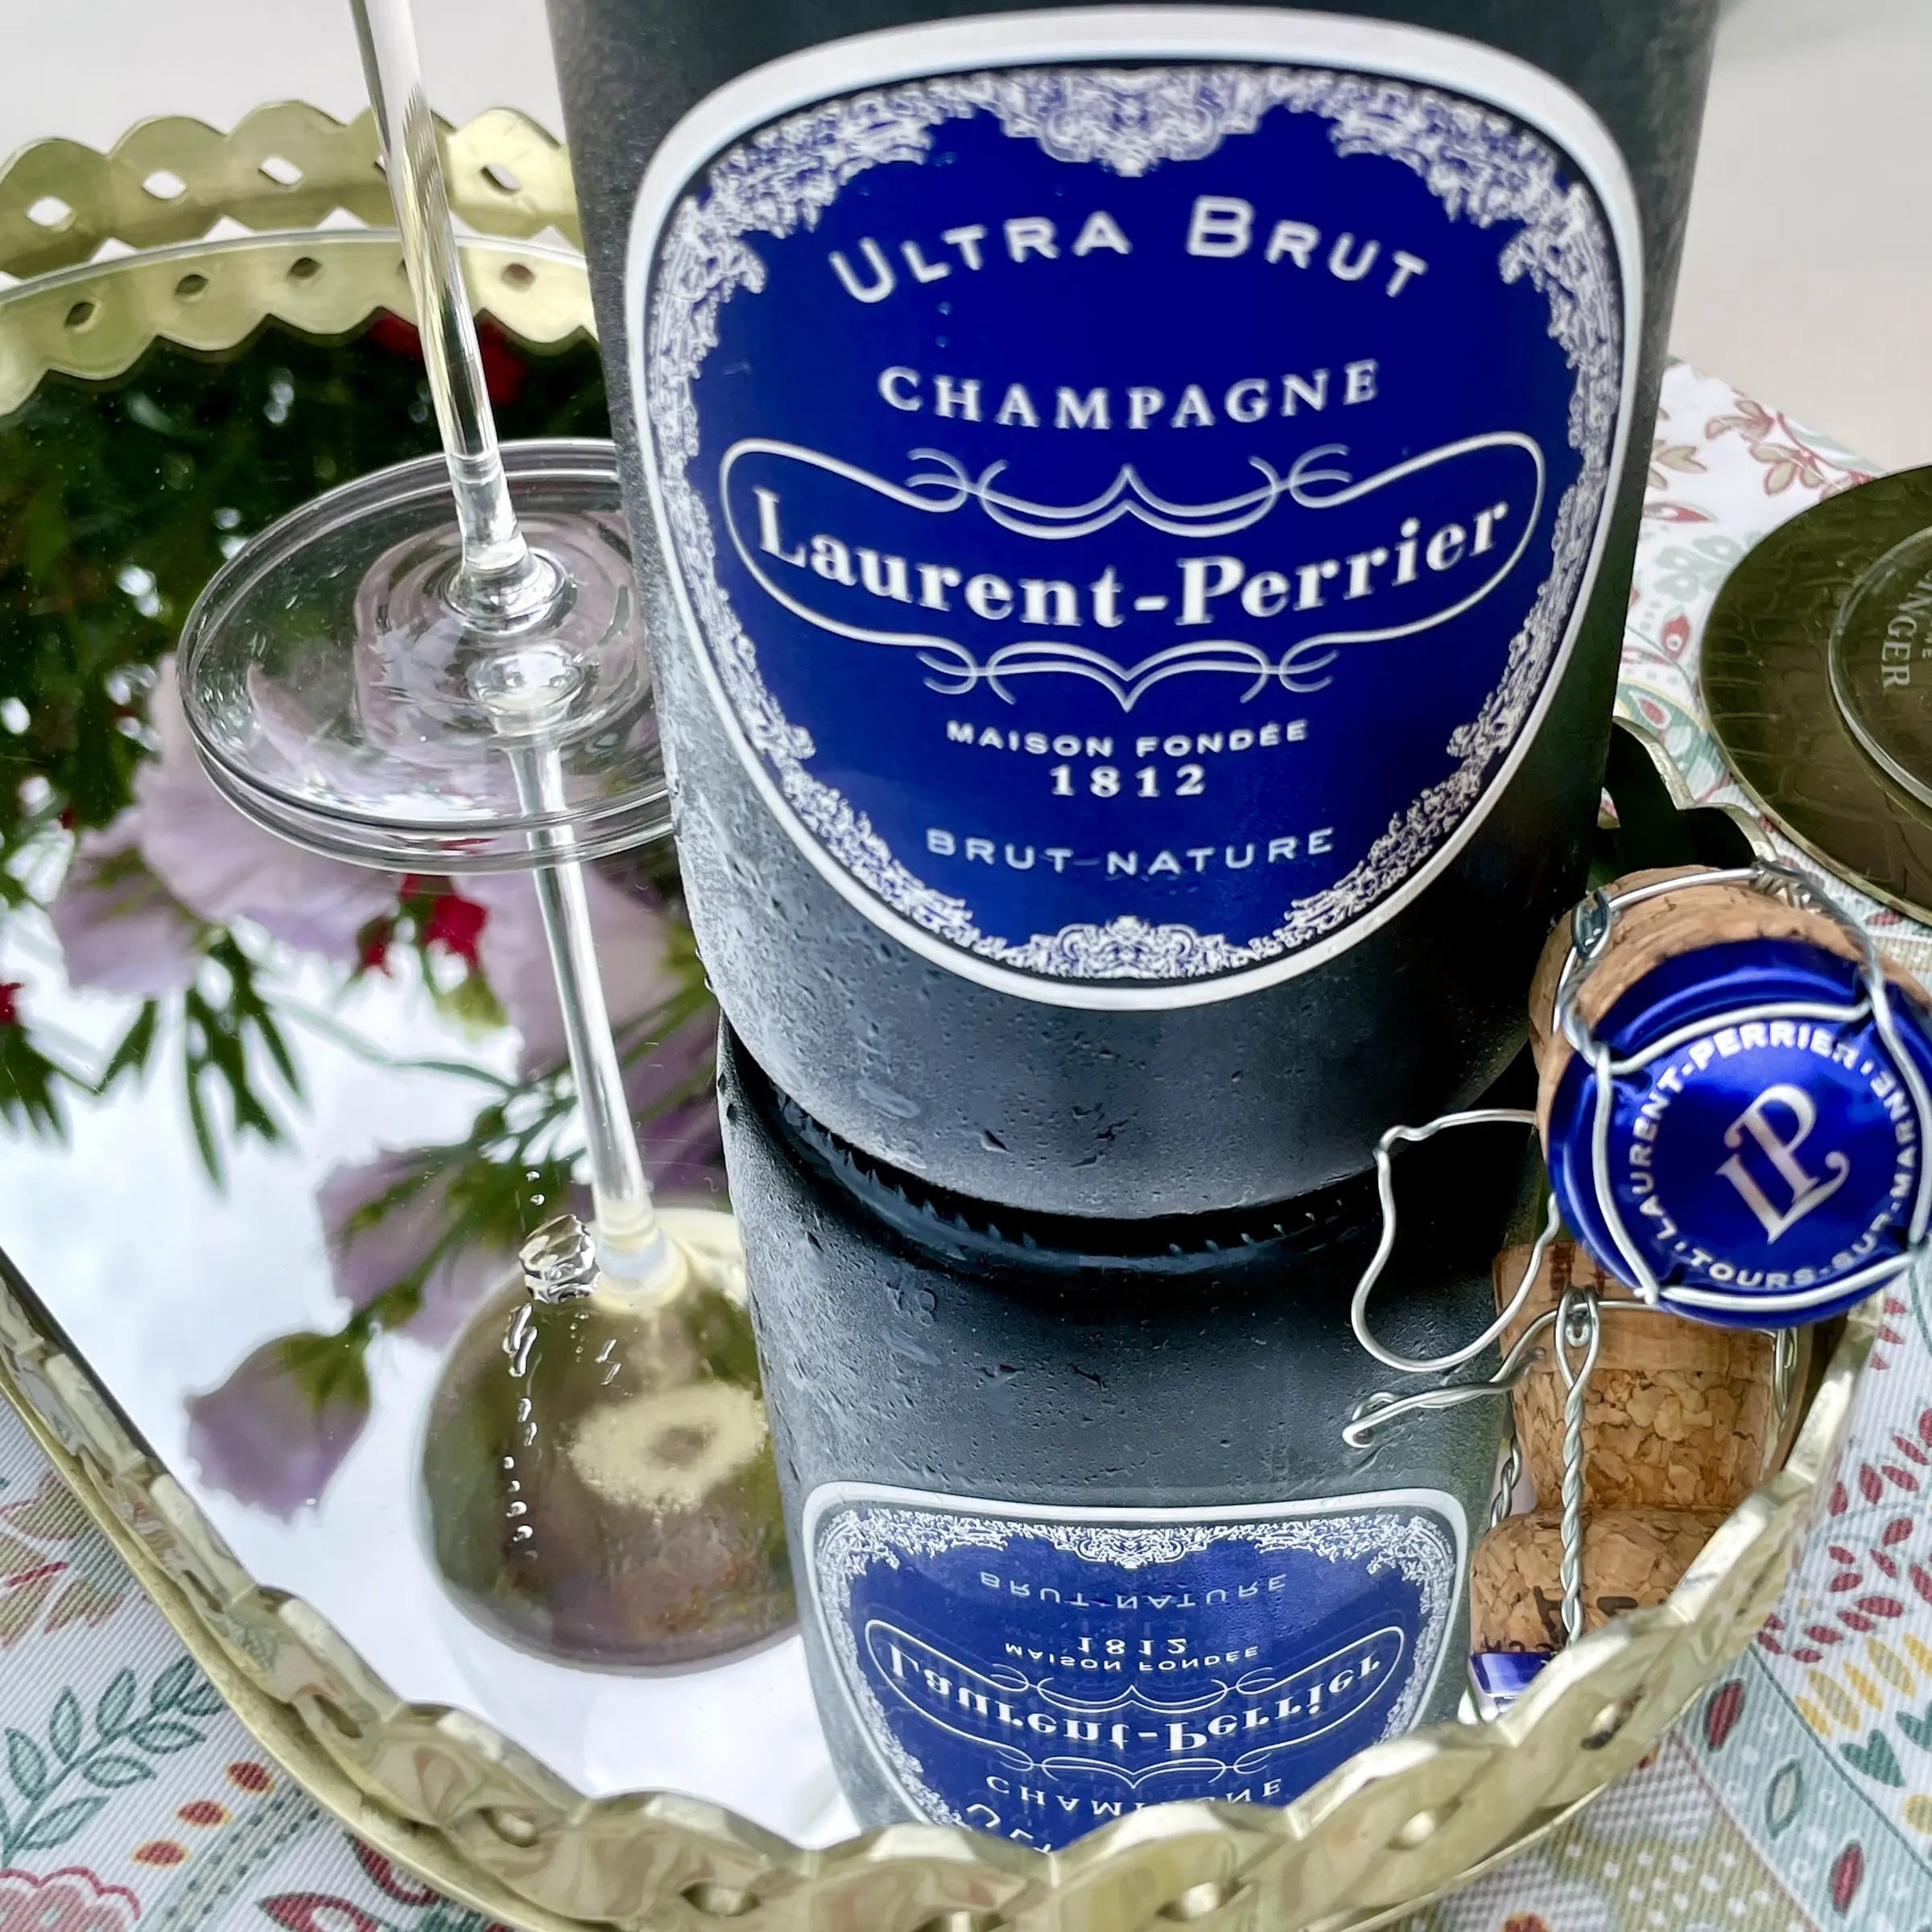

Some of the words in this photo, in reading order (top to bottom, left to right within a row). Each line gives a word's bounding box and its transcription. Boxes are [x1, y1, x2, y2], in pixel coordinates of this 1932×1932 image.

[877, 359, 1379, 431] CHAMPAGNE
[752, 486, 1510, 626] Laurent-Perrier
[946, 719, 1114, 758] MAISON
[1135, 718, 1307, 758] FONDÉE
[1051, 765, 1206, 798] 1812
[926, 827, 1072, 873] BRUT
[1106, 826, 1335, 876] NATURE
